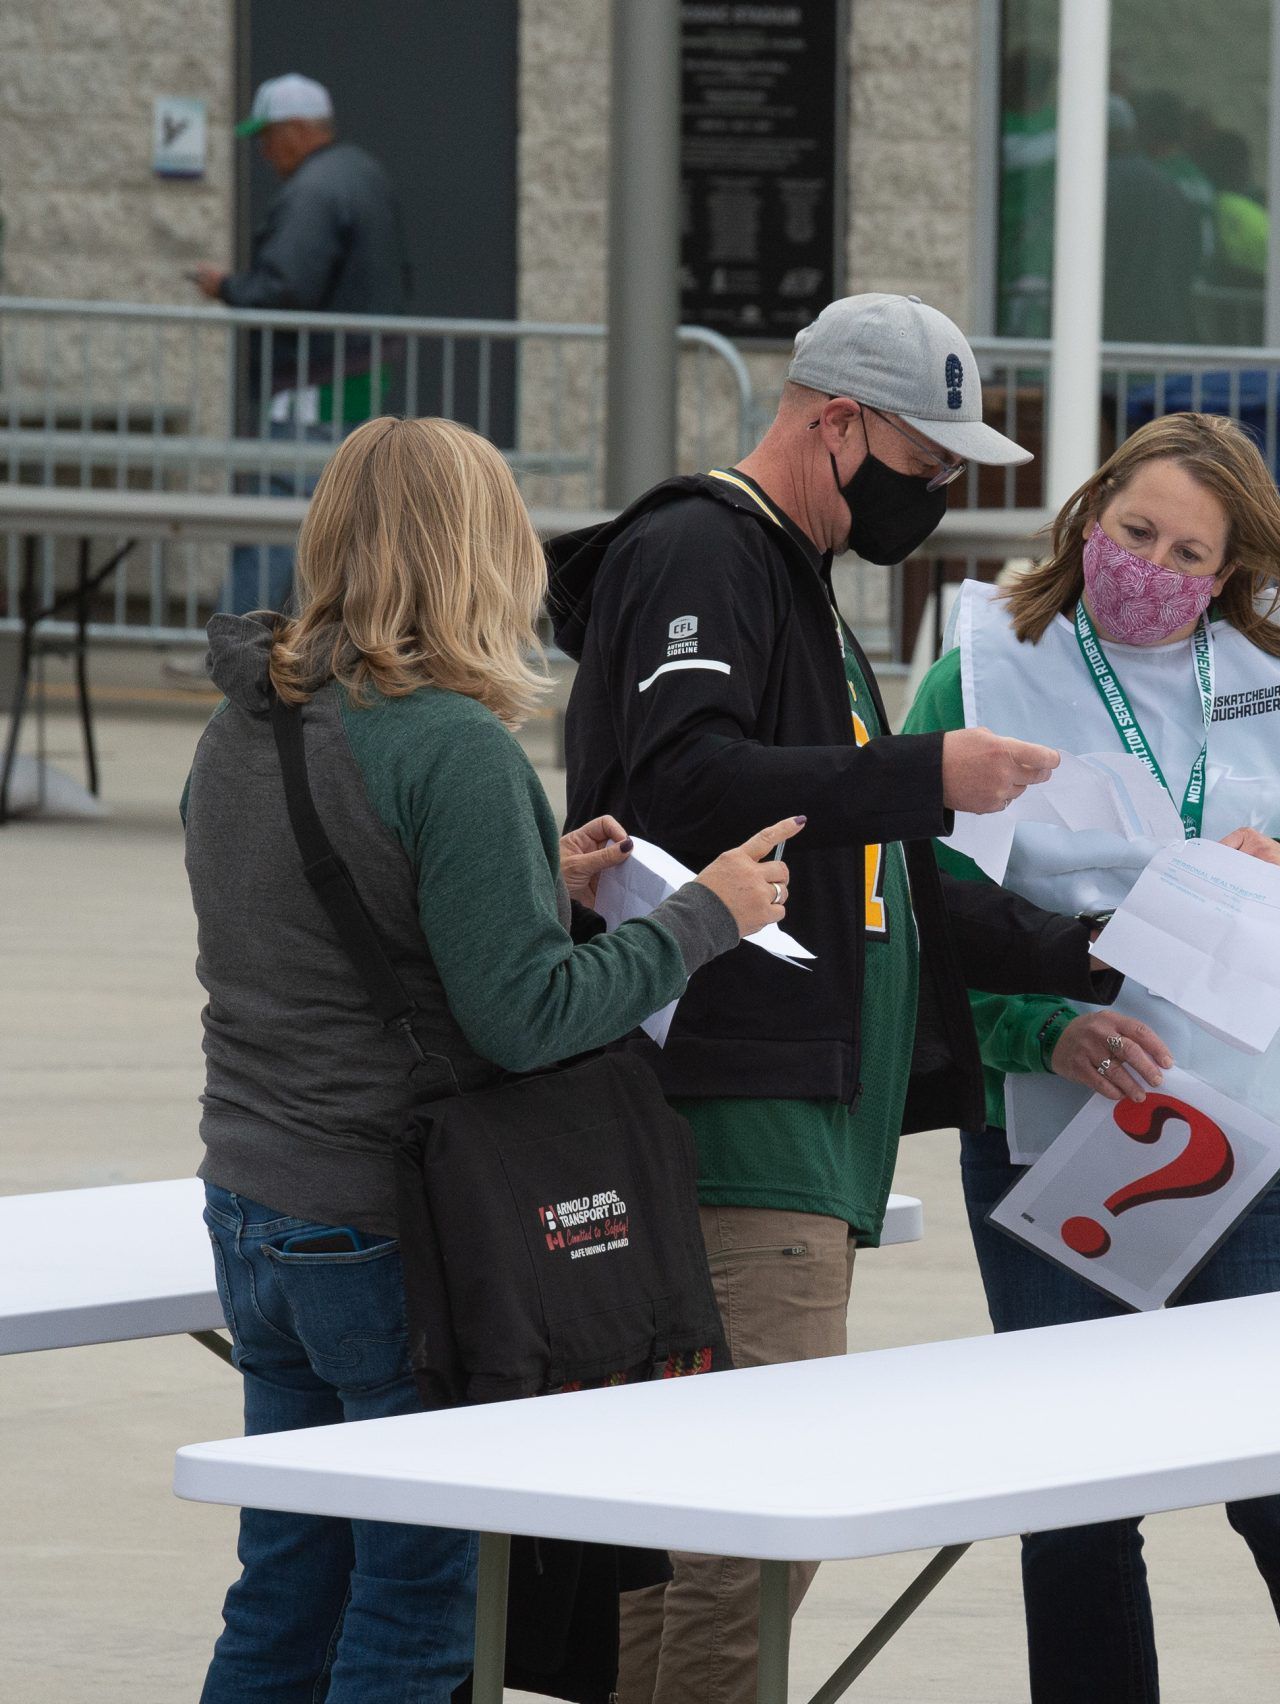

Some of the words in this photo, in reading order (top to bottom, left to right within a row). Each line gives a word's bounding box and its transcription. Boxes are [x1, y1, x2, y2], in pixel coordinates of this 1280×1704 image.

[673, 622, 693, 634] CFL
[1075, 602, 1092, 640] NATIO
[666, 646, 698, 657] SIDELINE
[667, 640, 699, 651] AUTHENTIC
[1082, 635, 1109, 677] RIDER
[1099, 676, 1134, 727] SERVING
[556, 1196, 590, 1216] ARNOLD
[592, 1190, 620, 1208] BROS.
[559, 1204, 610, 1228] TRANSPORT
[612, 1201, 627, 1216] LTD
[594, 1226, 601, 1238] to
[570, 1249, 585, 1260] SAFE
[585, 1243, 606, 1256] DRIVING
[607, 1237, 629, 1251] AWARD
